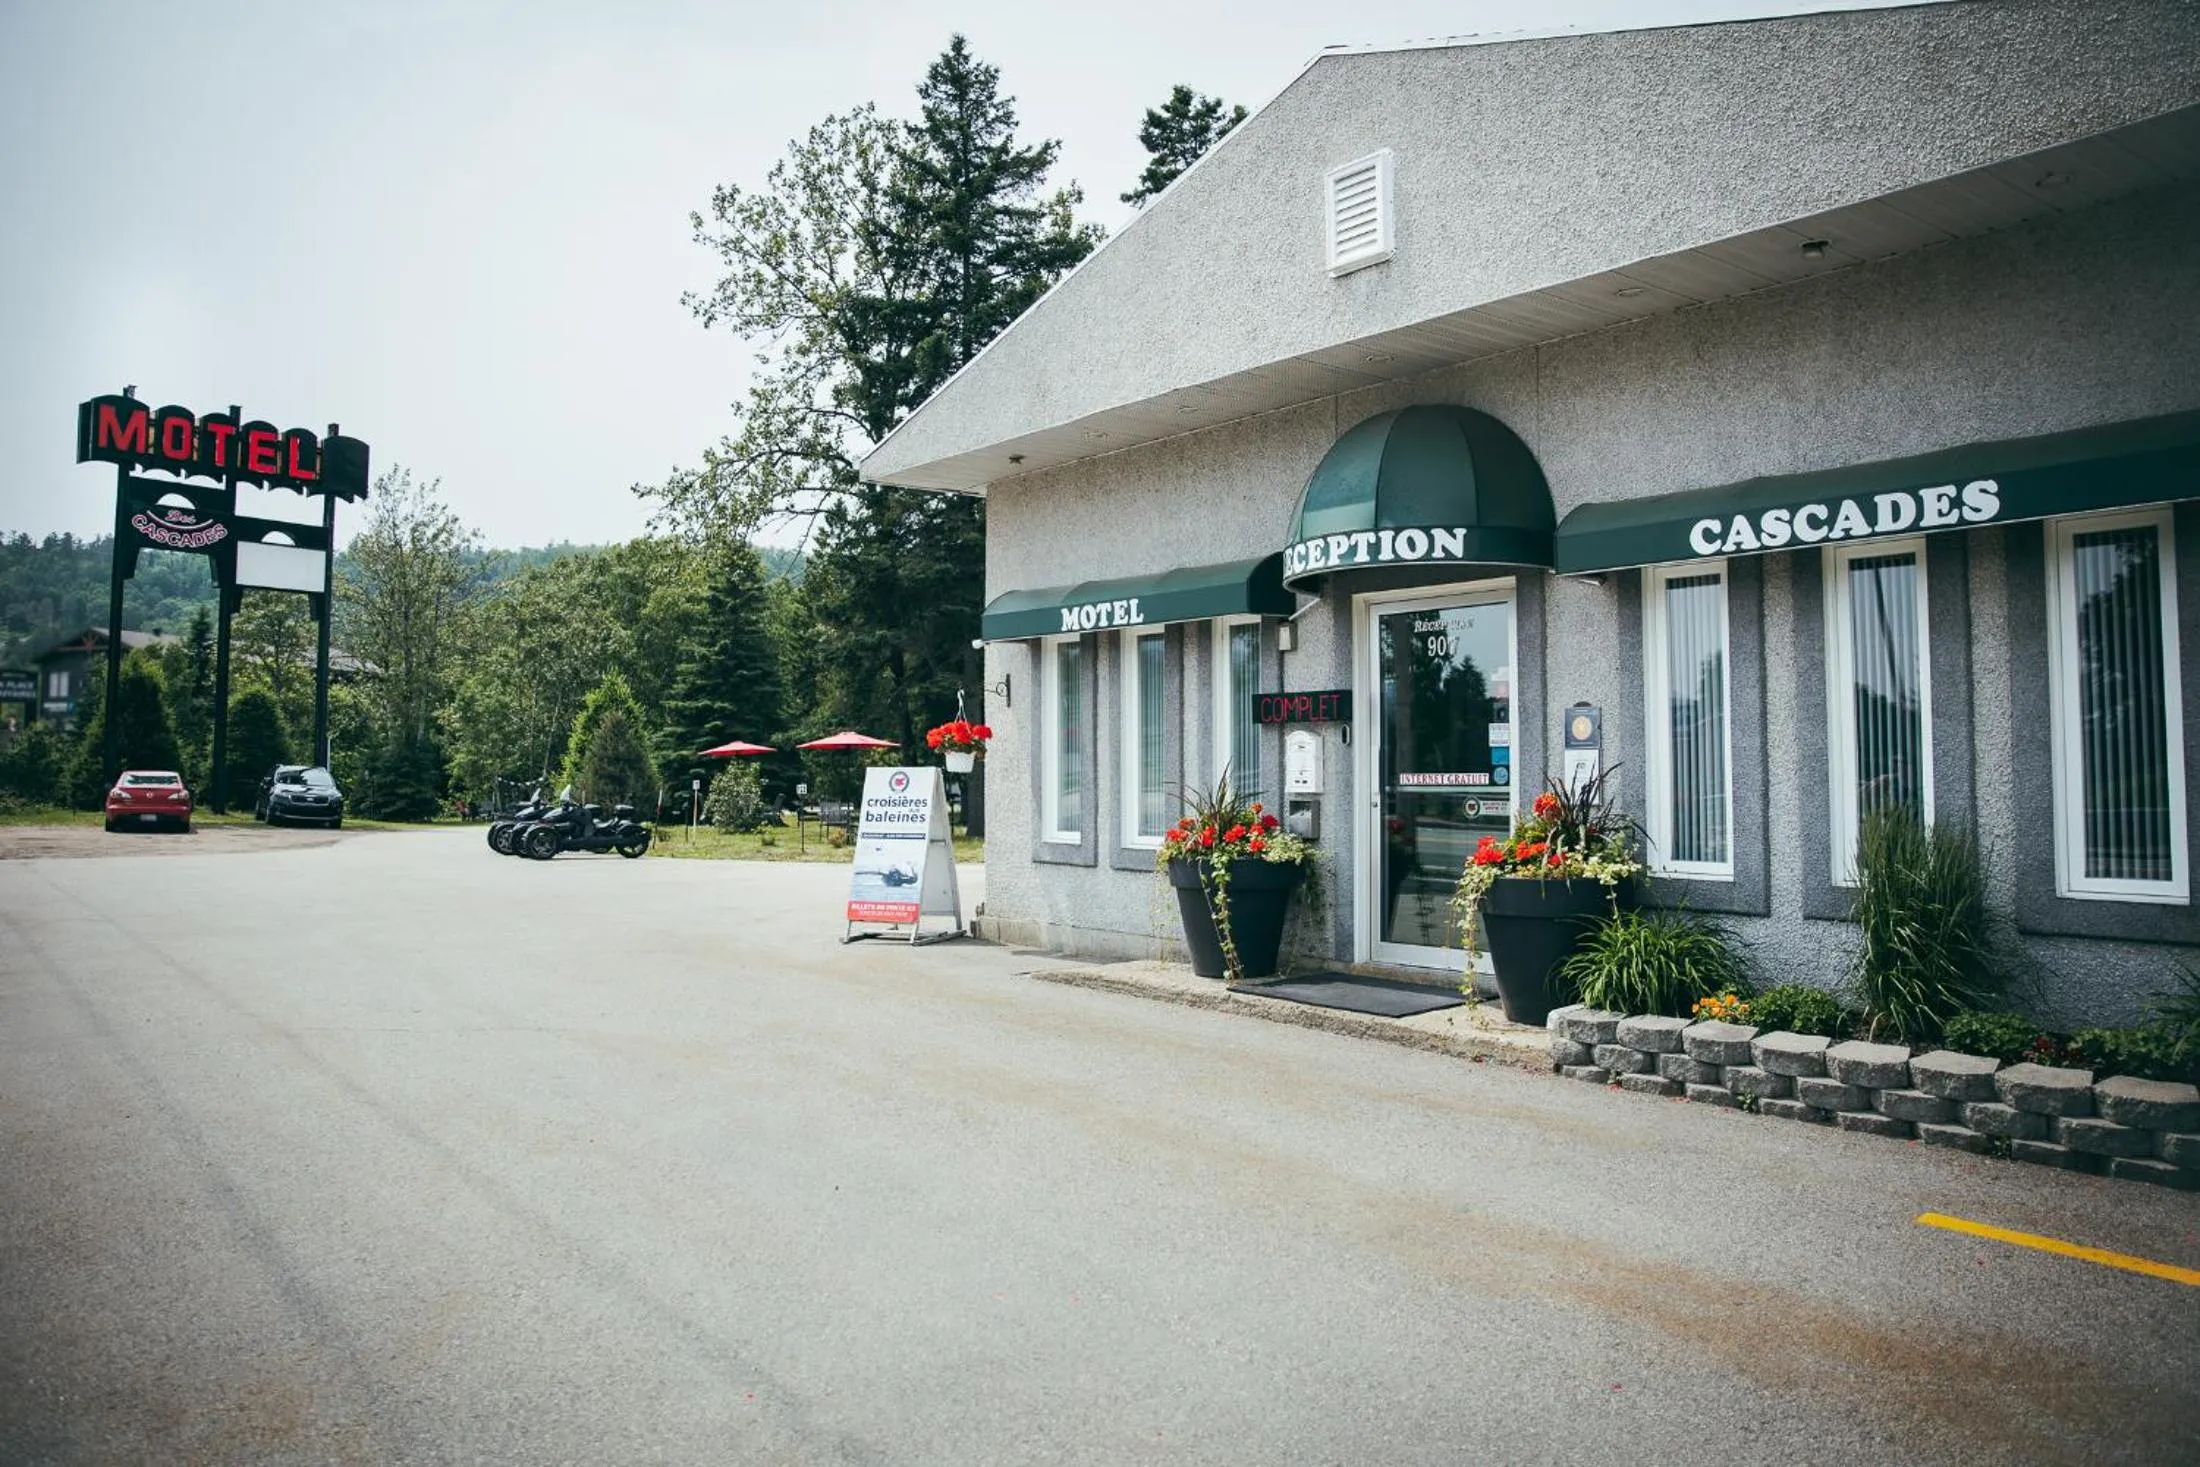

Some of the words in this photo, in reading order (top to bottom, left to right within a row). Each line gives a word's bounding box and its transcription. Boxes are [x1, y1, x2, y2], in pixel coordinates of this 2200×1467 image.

[98, 404, 318, 481] MOTEL
[131, 514, 228, 548] CASCADES
[1689, 479, 2000, 555] CASCADES
[1283, 527, 1467, 580] ECEPTION
[1060, 598, 1144, 632] MOTEL
[1427, 635, 1460, 658] 907
[1261, 694, 1341, 722] COMPLET
[1400, 773, 1443, 785] INTERNET
[865, 810, 926, 823] baleines
[867, 795, 928, 808] croisières
